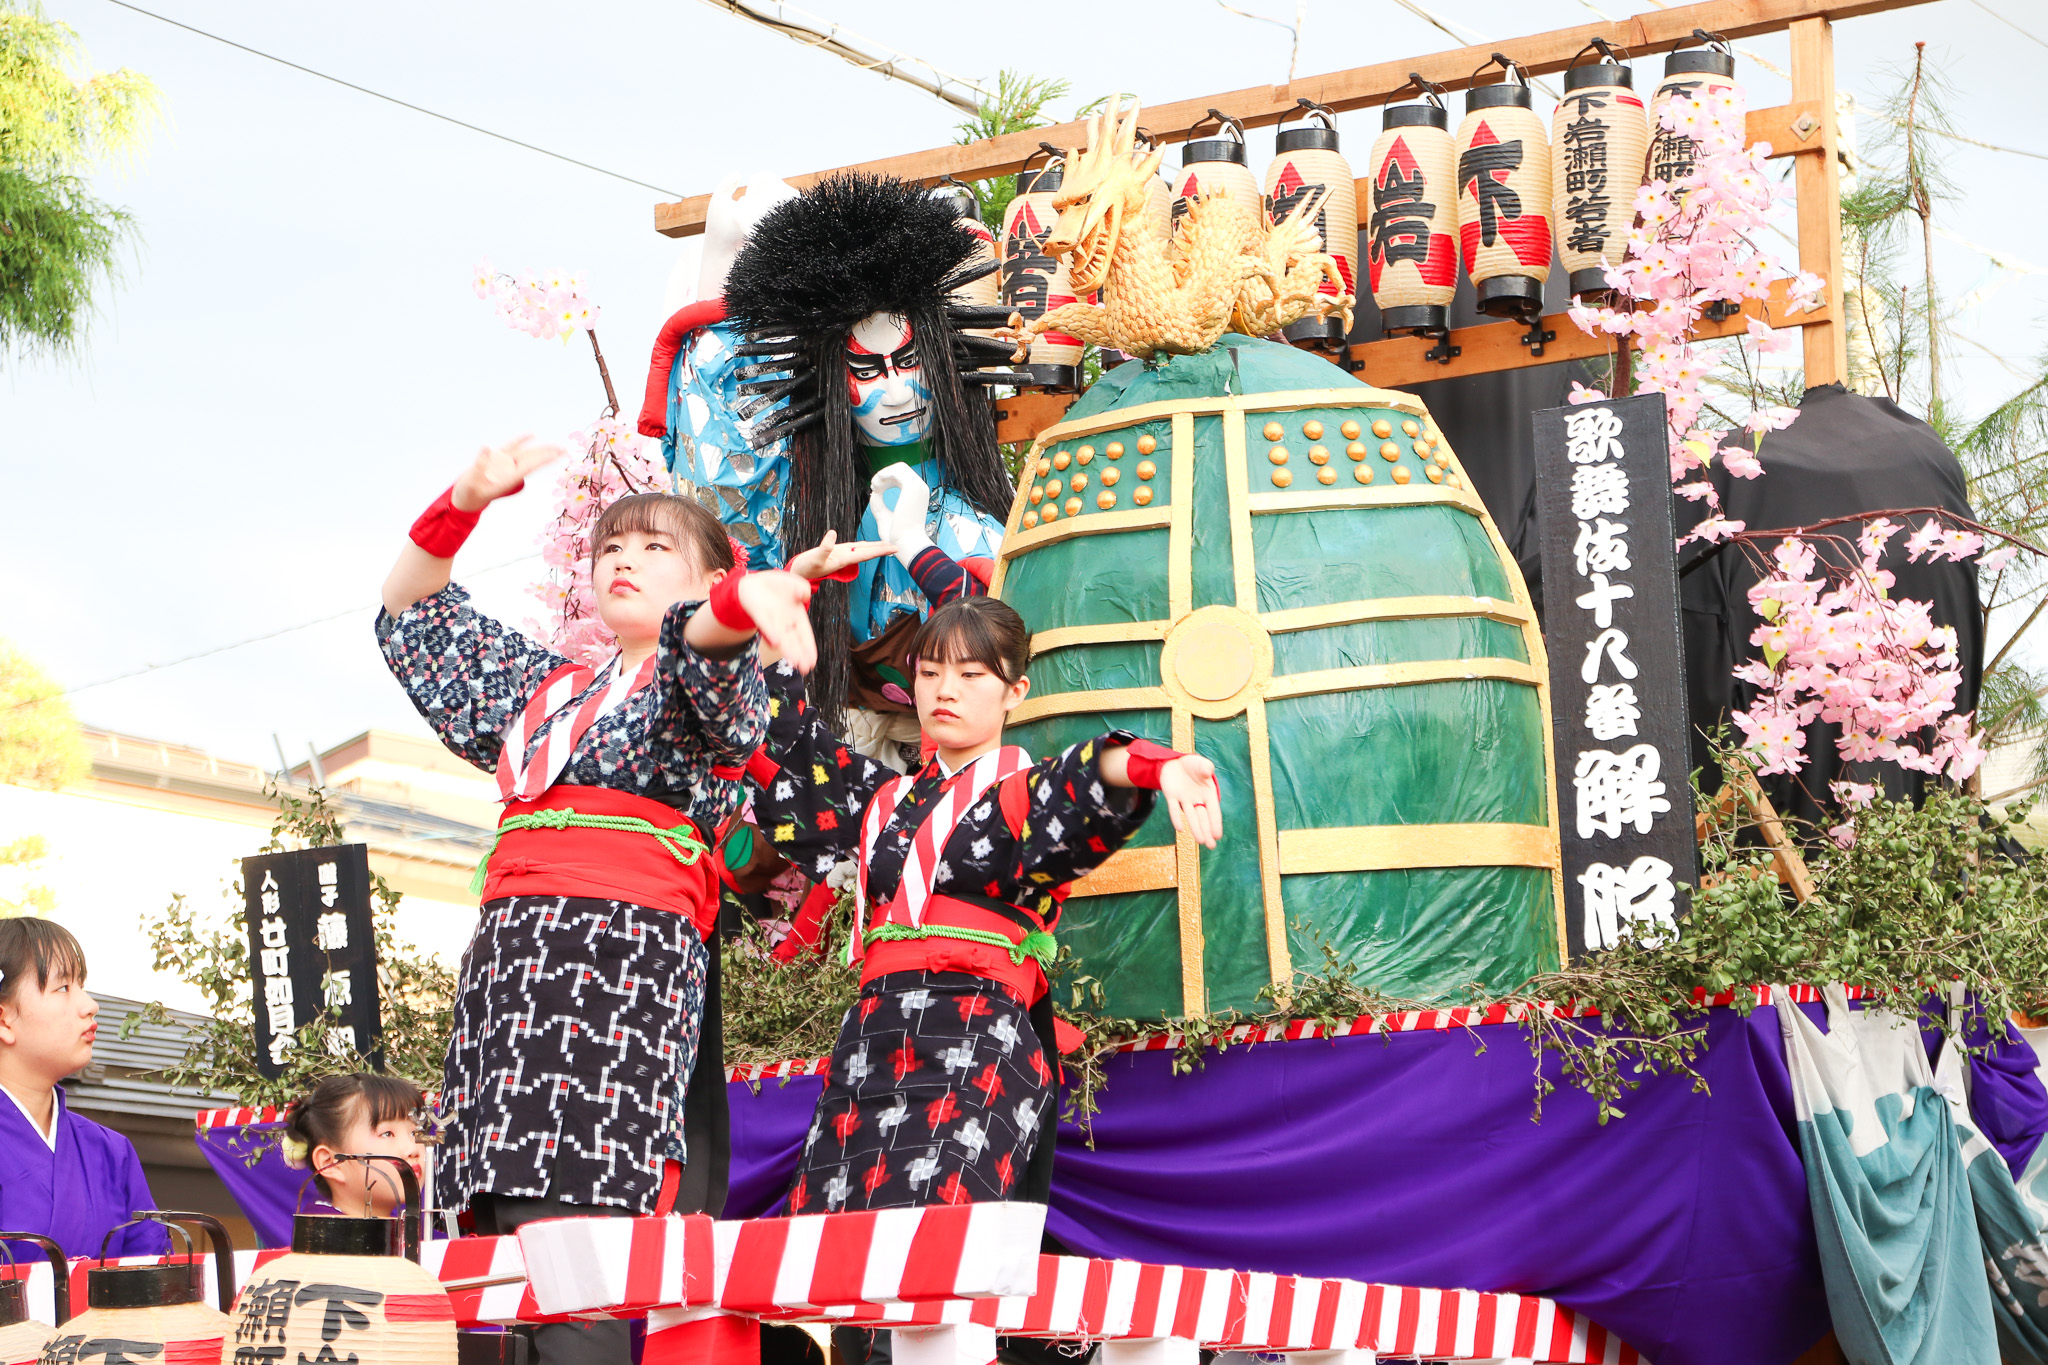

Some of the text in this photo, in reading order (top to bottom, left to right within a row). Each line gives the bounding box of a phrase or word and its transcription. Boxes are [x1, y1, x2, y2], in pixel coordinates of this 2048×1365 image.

[1370, 159, 1437, 267] 岩
[1458, 139, 1524, 248] 下
[1562, 91, 1611, 254] 下岩瀬町若者
